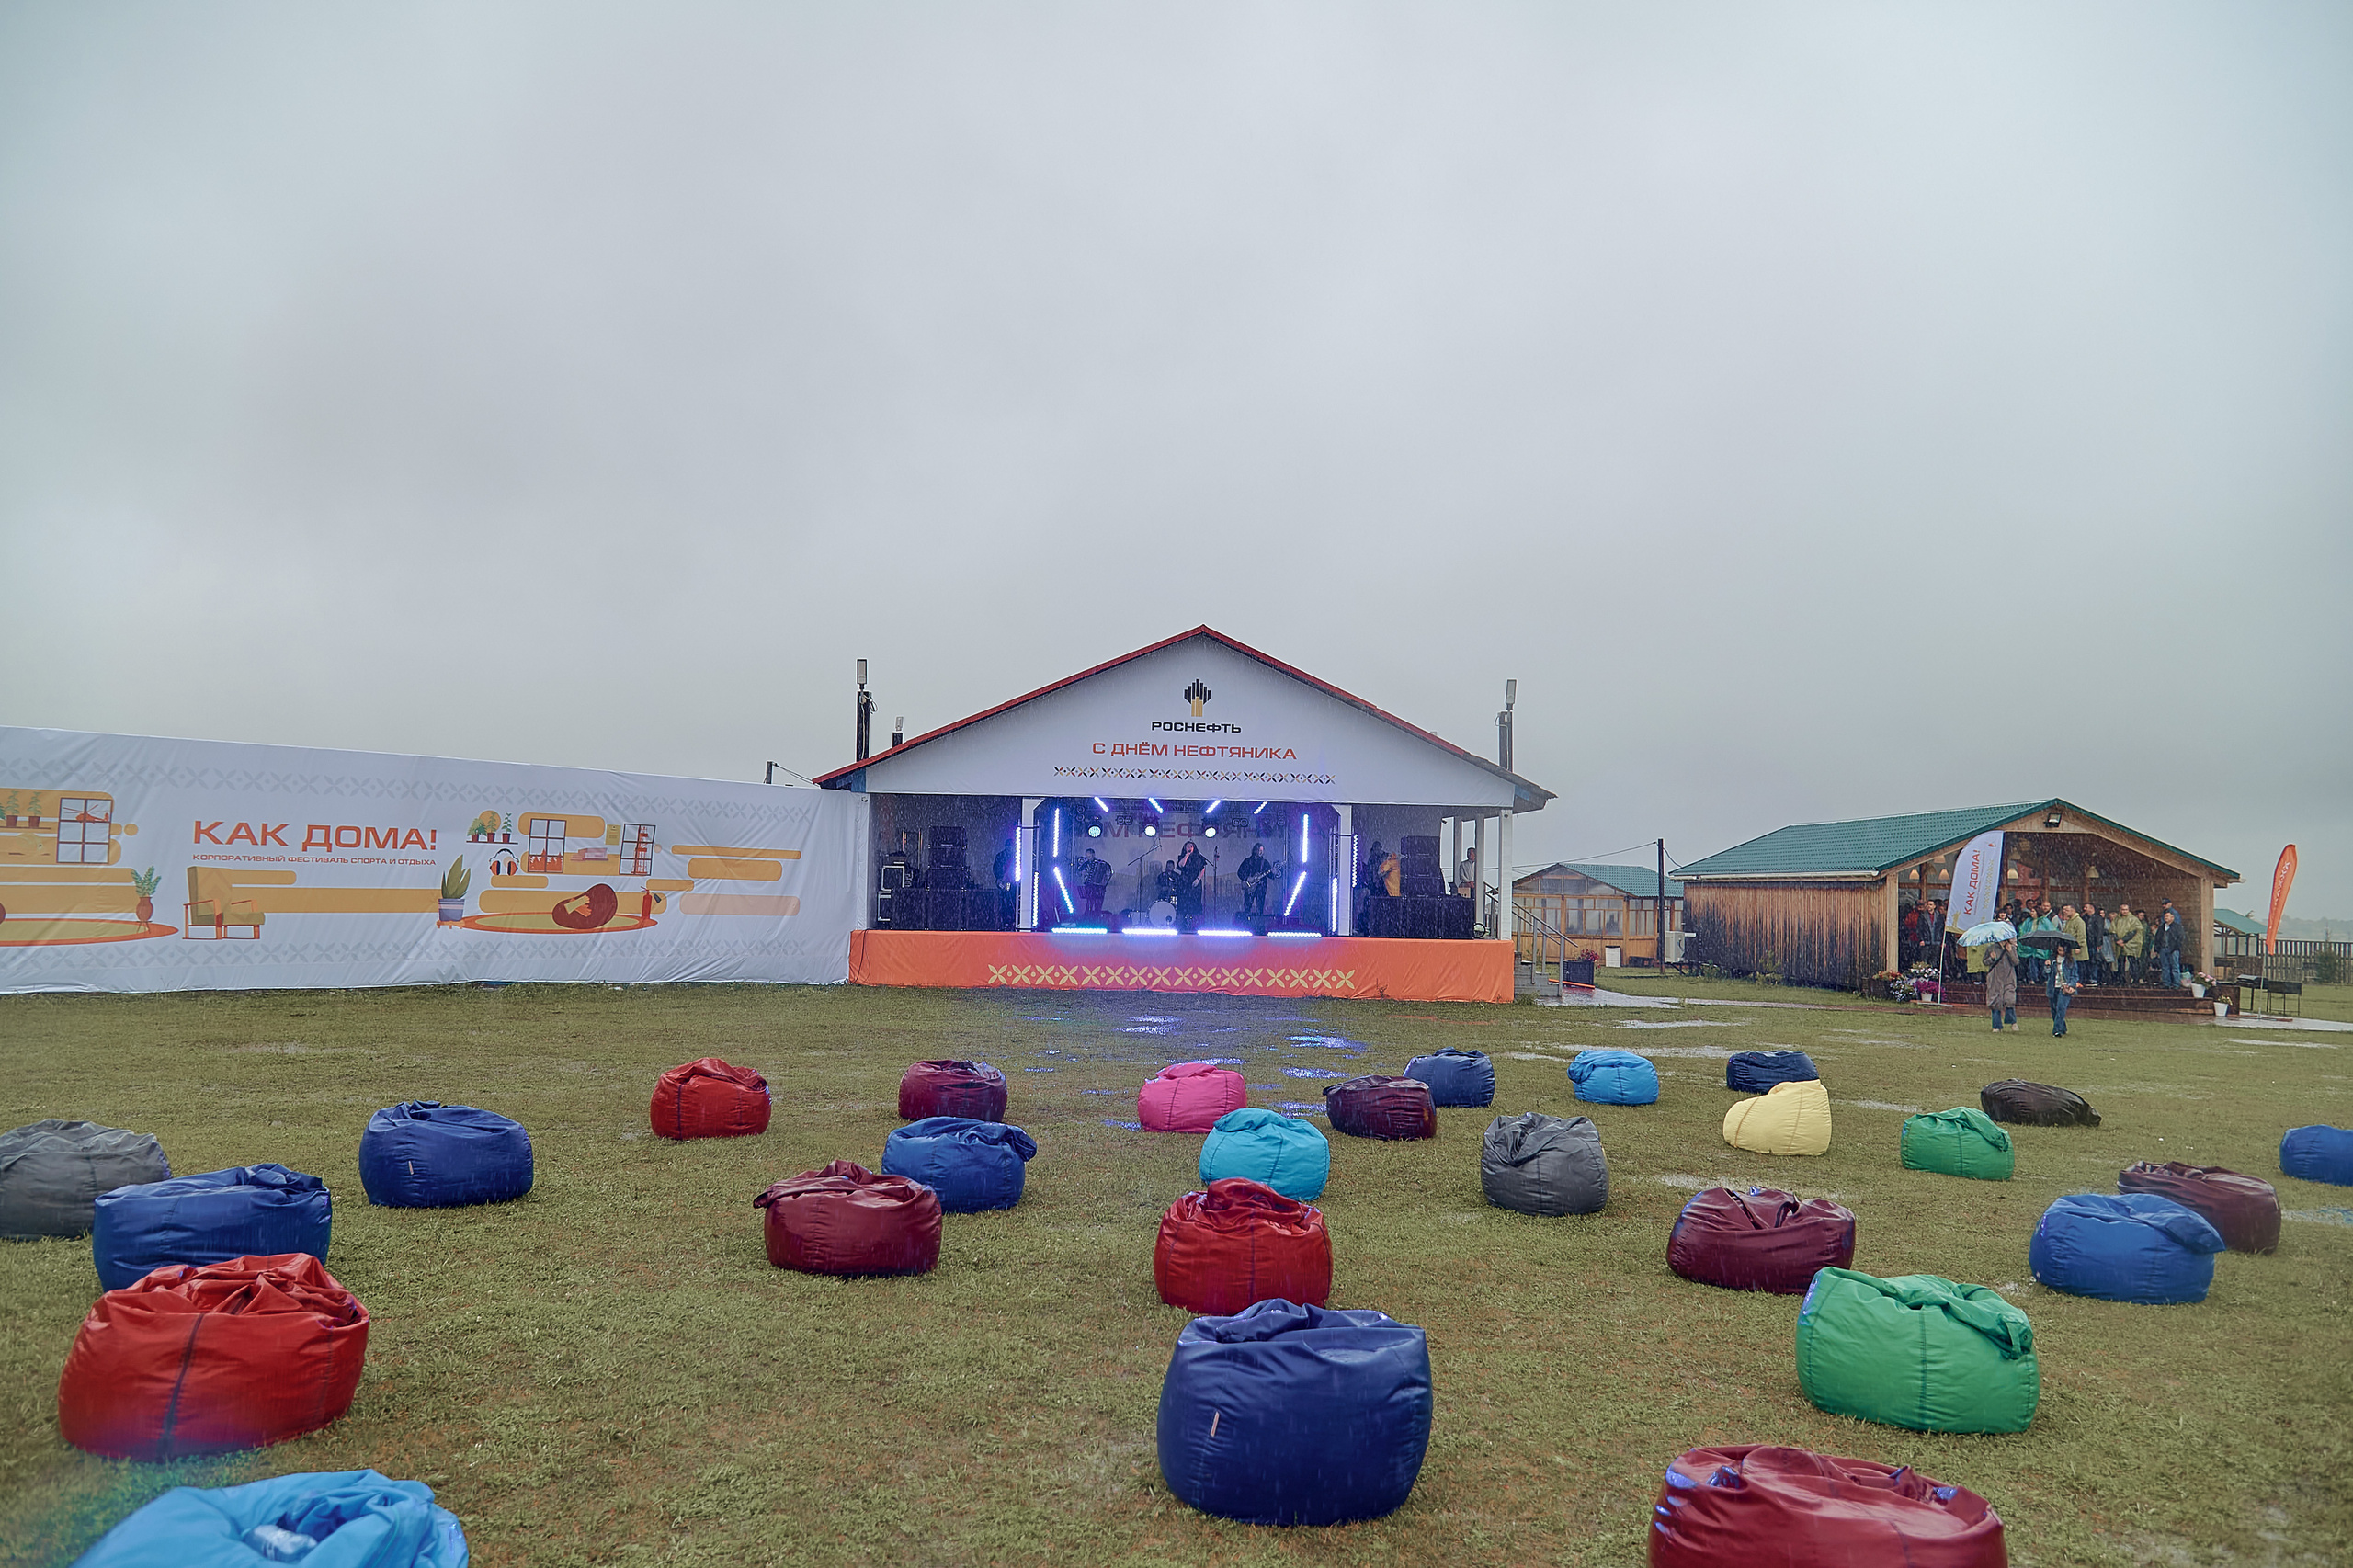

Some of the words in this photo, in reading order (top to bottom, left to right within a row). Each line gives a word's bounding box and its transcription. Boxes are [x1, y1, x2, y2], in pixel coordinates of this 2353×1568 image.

[1151, 722, 1242, 733] РОСНЕФТЬ
[1092, 742, 1106, 754] С
[1110, 741, 1168, 756] ДНЁМ
[1173, 744, 1297, 759] НЕФТЯНИКА
[194, 820, 290, 846] КАК
[301, 824, 437, 853] ДОМА!
[192, 854, 286, 862] КОРПОРАТИВНЫЙ
[1963, 892, 1975, 915] КАК
[1969, 849, 1981, 889] ДОМА!
